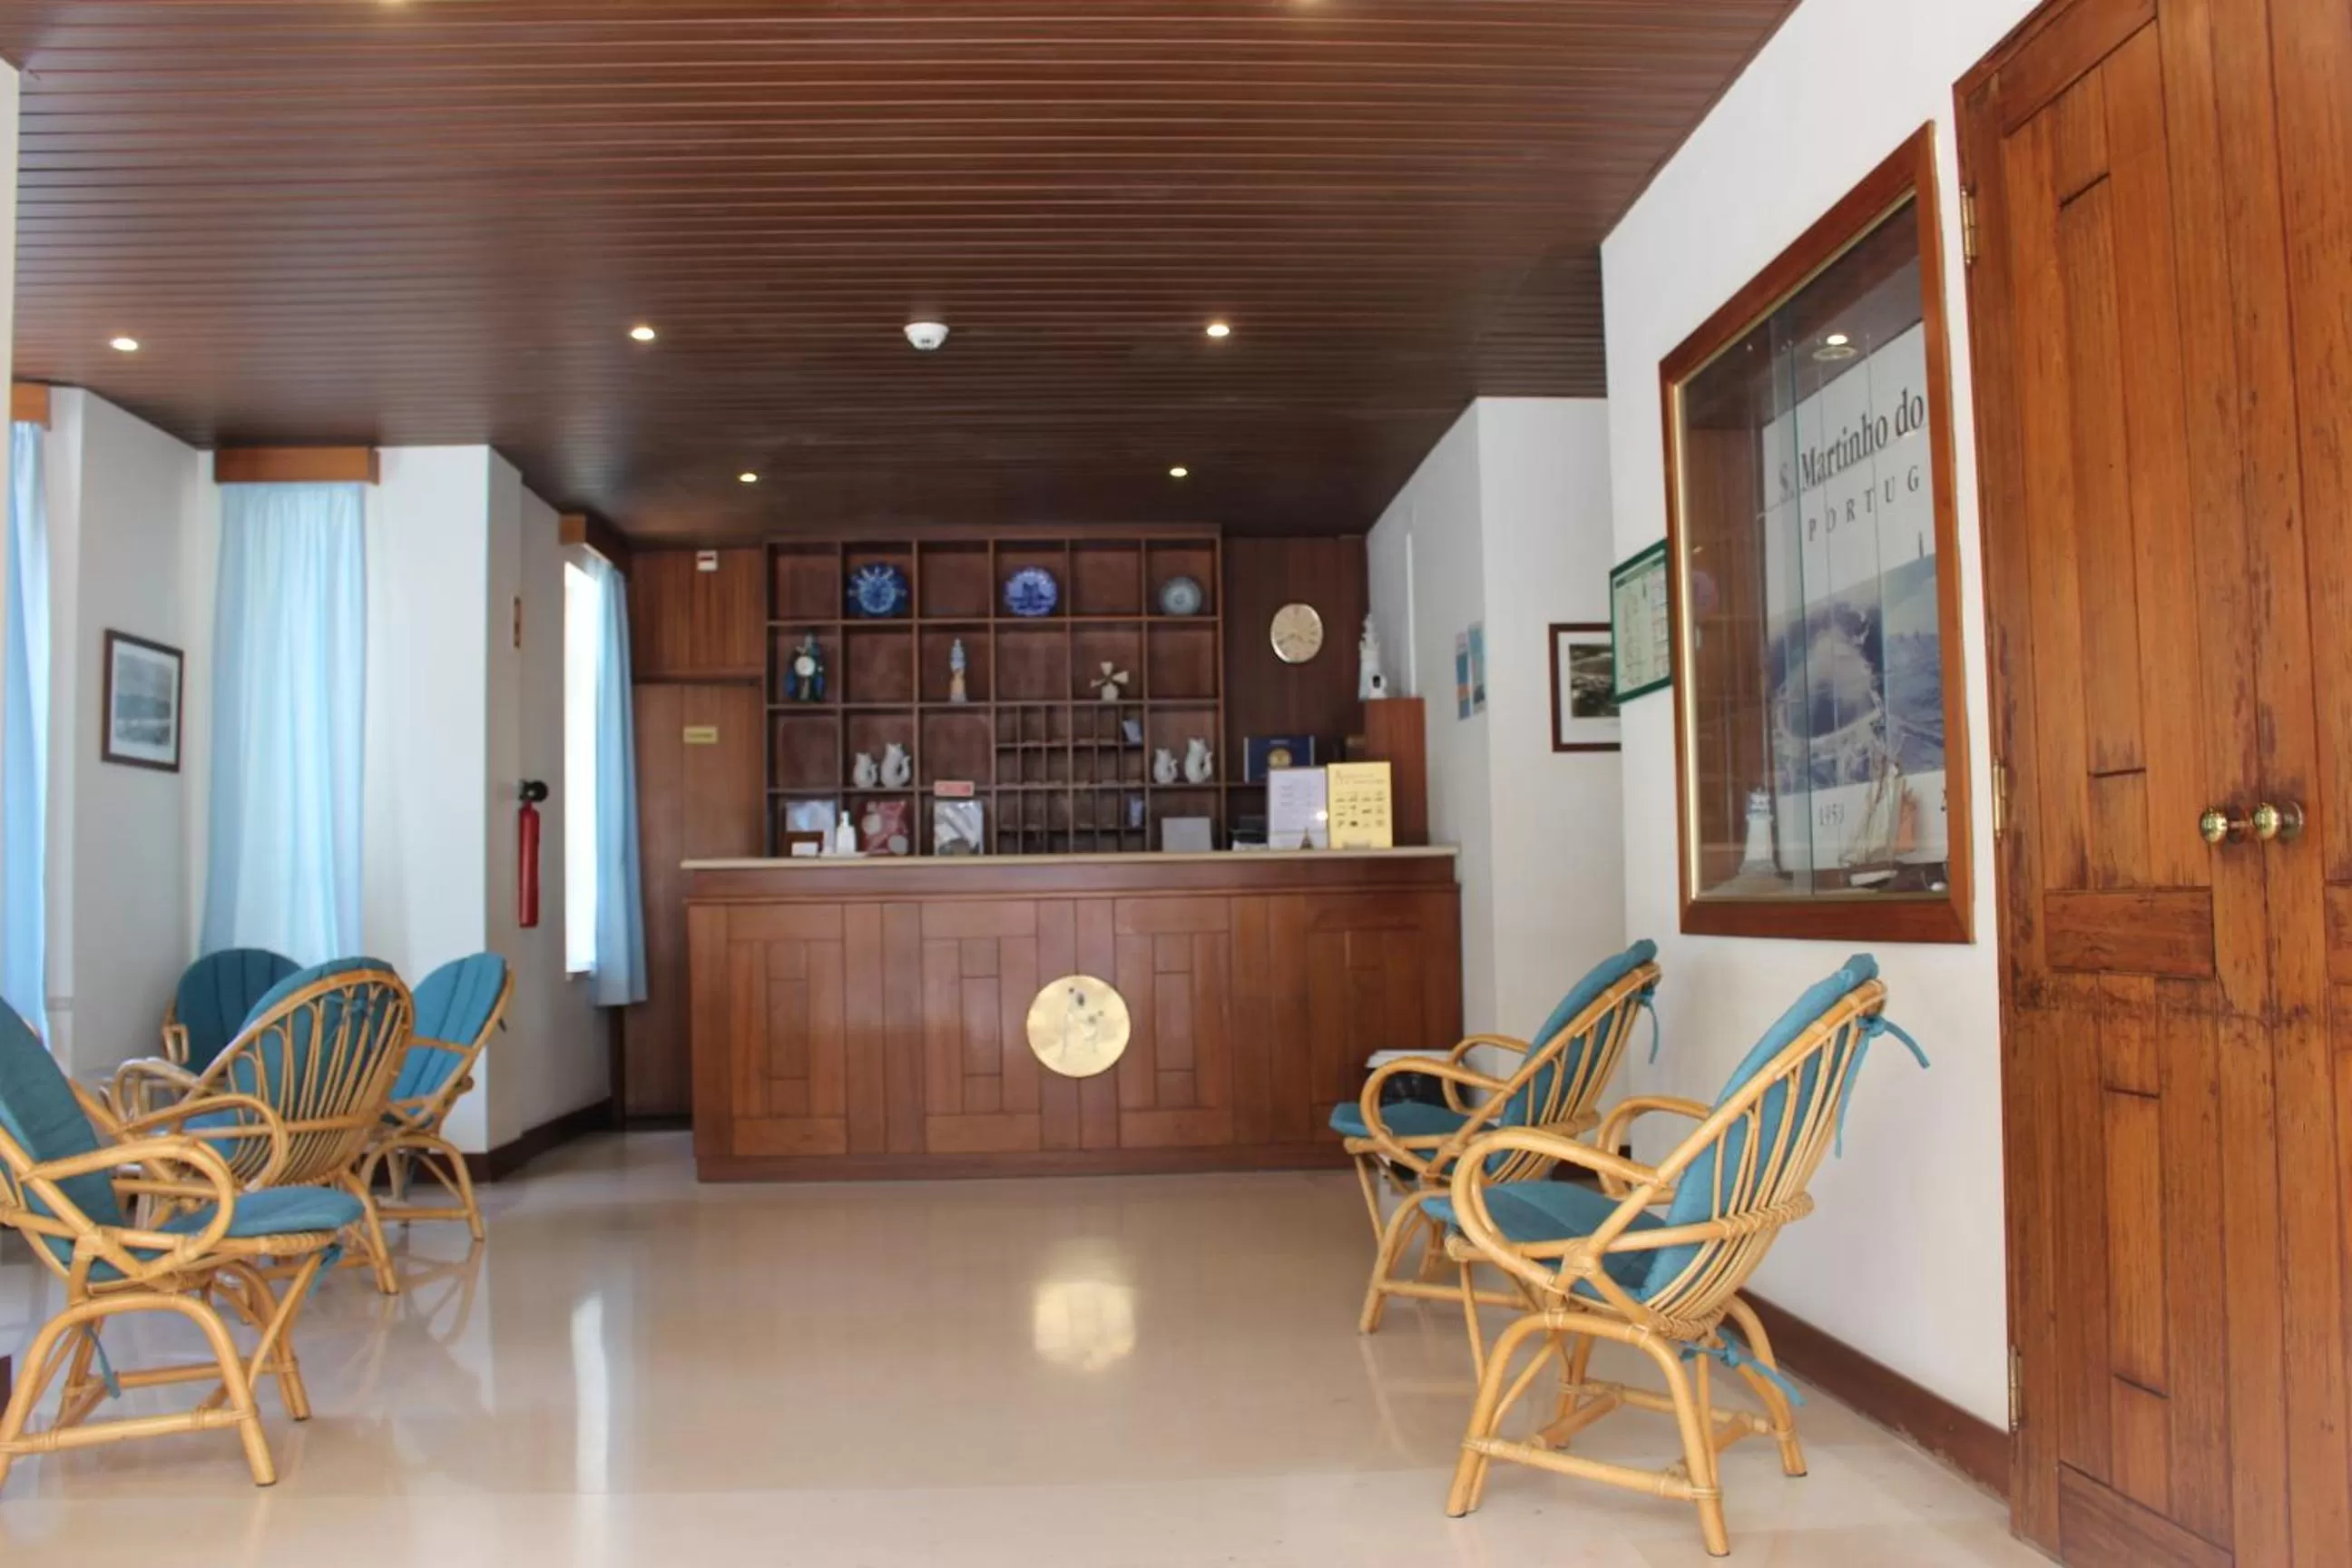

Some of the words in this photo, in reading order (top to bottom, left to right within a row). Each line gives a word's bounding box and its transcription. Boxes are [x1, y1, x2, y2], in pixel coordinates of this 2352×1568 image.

[1800, 411, 1888, 488] Martinho
[1895, 387, 1924, 437] do
[1808, 465, 1920, 542] PORTUG
